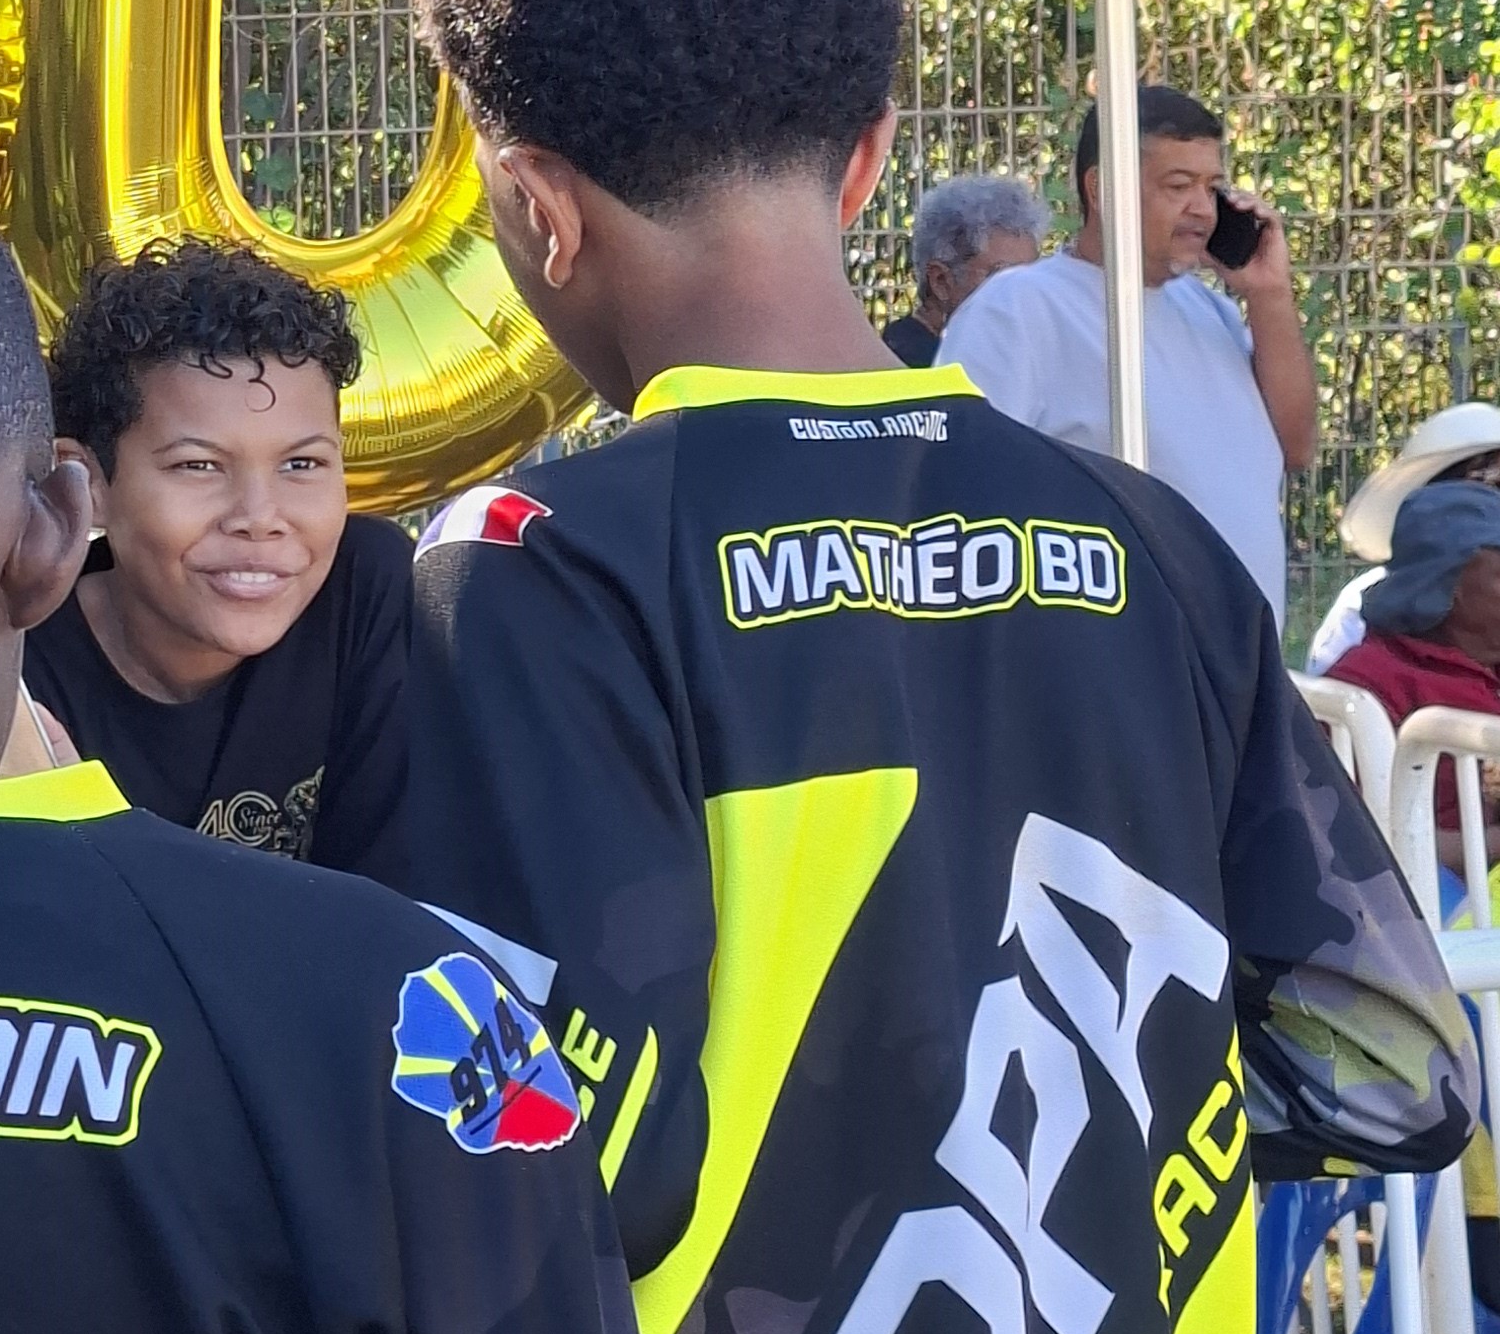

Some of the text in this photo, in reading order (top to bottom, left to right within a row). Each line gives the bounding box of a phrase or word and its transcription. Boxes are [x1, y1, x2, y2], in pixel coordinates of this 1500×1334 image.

[732, 523, 1118, 615] MATHÉO BD
[450, 995, 532, 1125] 974
[1158, 1019, 1250, 1317] AC
